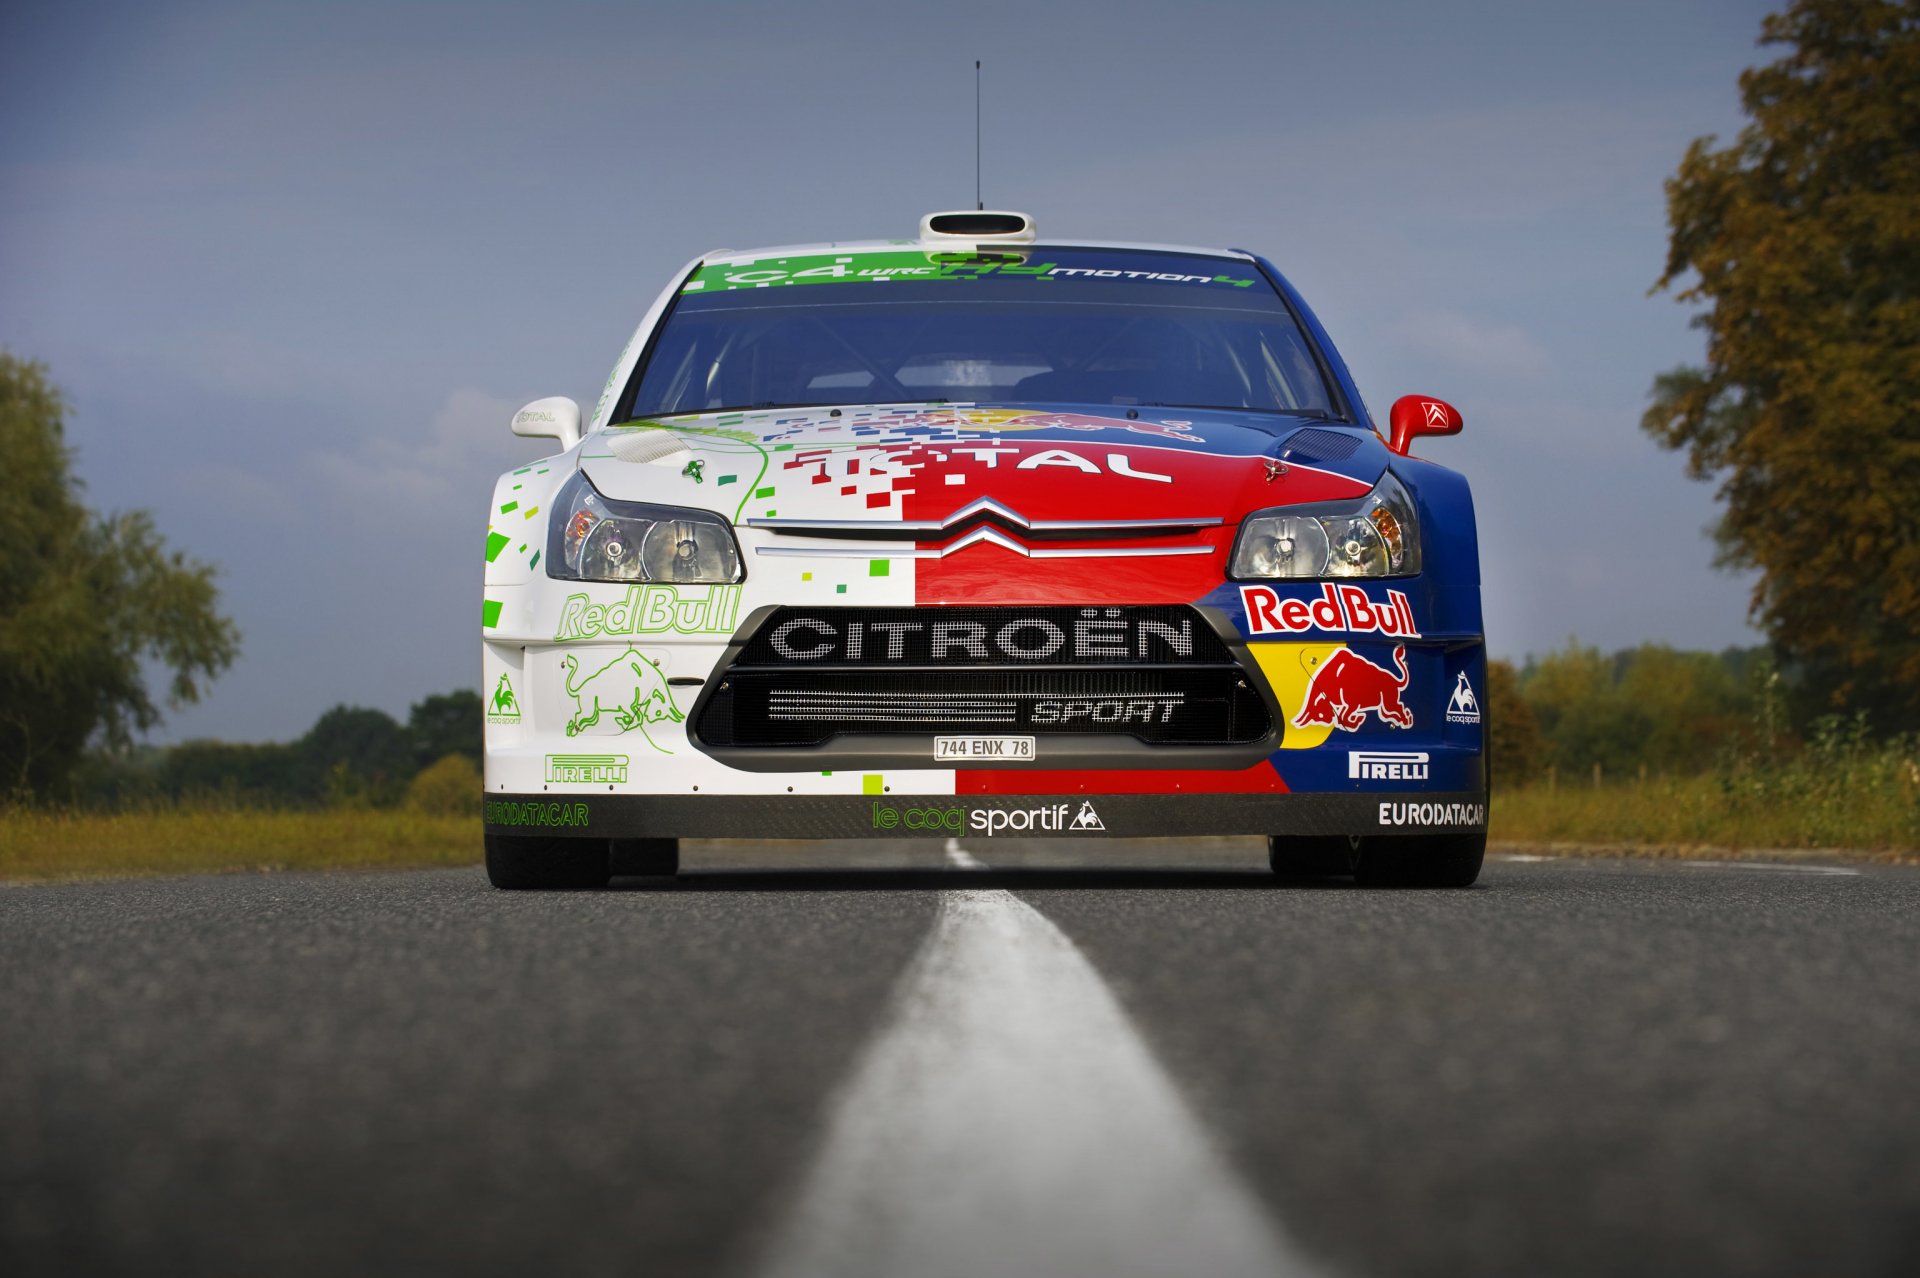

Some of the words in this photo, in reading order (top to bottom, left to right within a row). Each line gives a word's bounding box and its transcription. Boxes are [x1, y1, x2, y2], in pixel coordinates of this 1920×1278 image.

[725, 264, 854, 283] C4
[554, 584, 644, 642] Red
[637, 584, 743, 634] Bull
[1239, 582, 1347, 635] Red
[1337, 584, 1422, 639] Bull
[769, 608, 1193, 660] CITROËN
[1031, 699, 1185, 724] SPORT
[941, 741, 966, 755] 744
[973, 741, 1003, 754] ENX
[1012, 741, 1029, 754] 78
[545, 754, 629, 783] PIRELLI
[1348, 751, 1429, 779] PIRELLI
[487, 801, 589, 826] EURODATACAR
[873, 802, 899, 828] le
[904, 808, 965, 836] coq
[970, 804, 1068, 836] sportif
[1379, 802, 1484, 825] EURODATACAR
